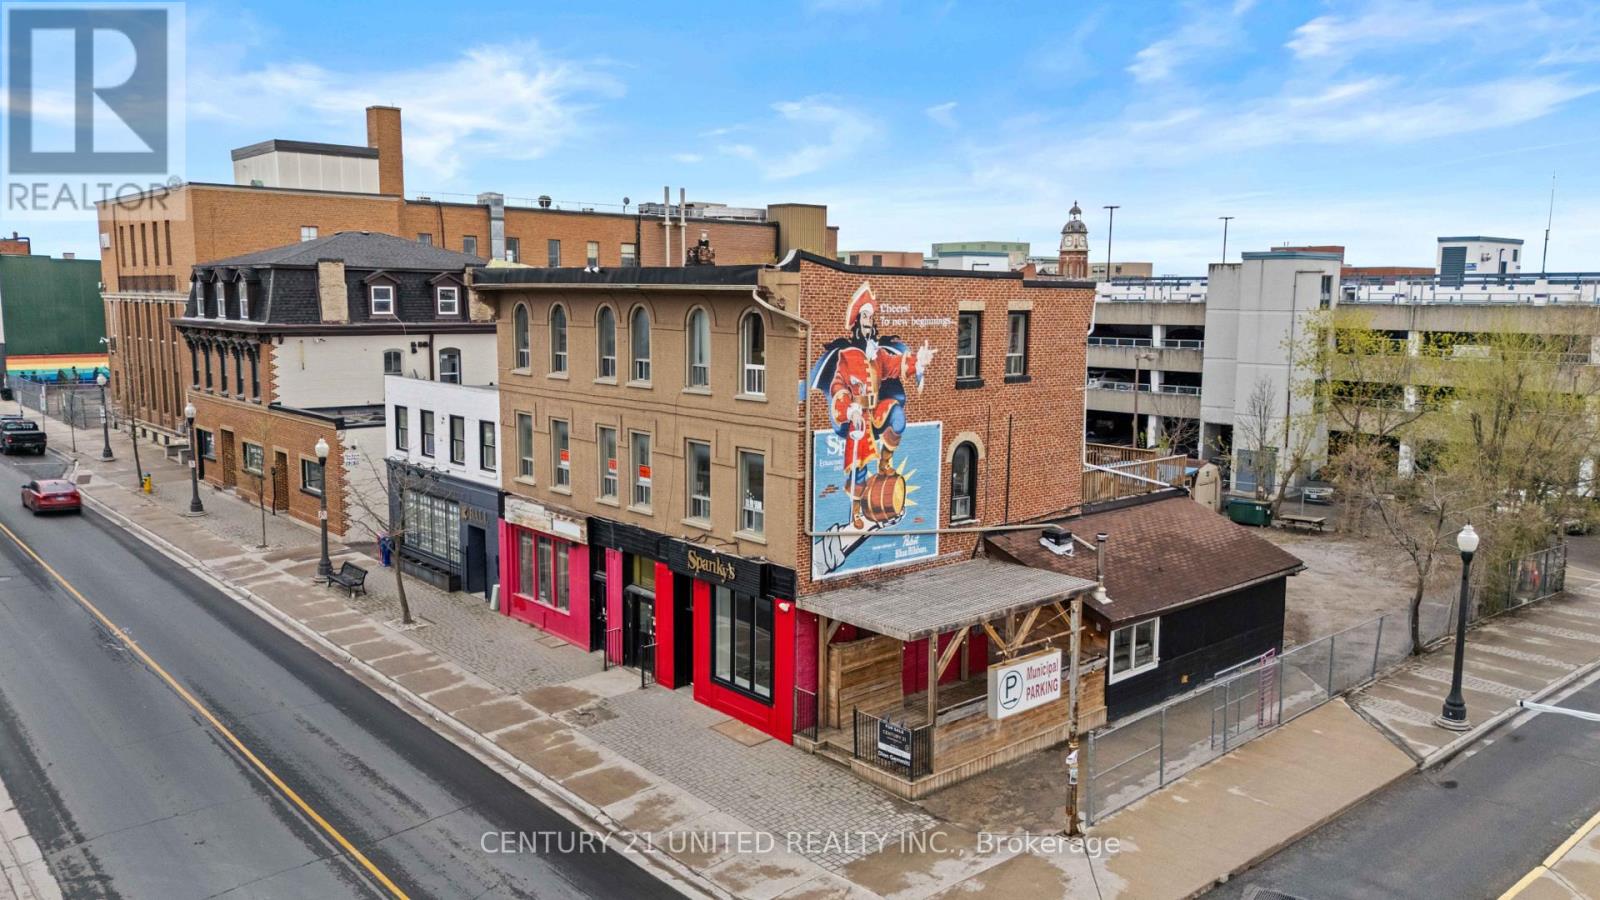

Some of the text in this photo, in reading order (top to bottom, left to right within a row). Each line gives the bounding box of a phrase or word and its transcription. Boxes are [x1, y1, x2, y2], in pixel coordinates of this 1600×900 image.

[687, 550, 736, 584] Spanky's
[1026, 658, 1059, 681] Municipal
[1026, 678, 1059, 701] PARKING
